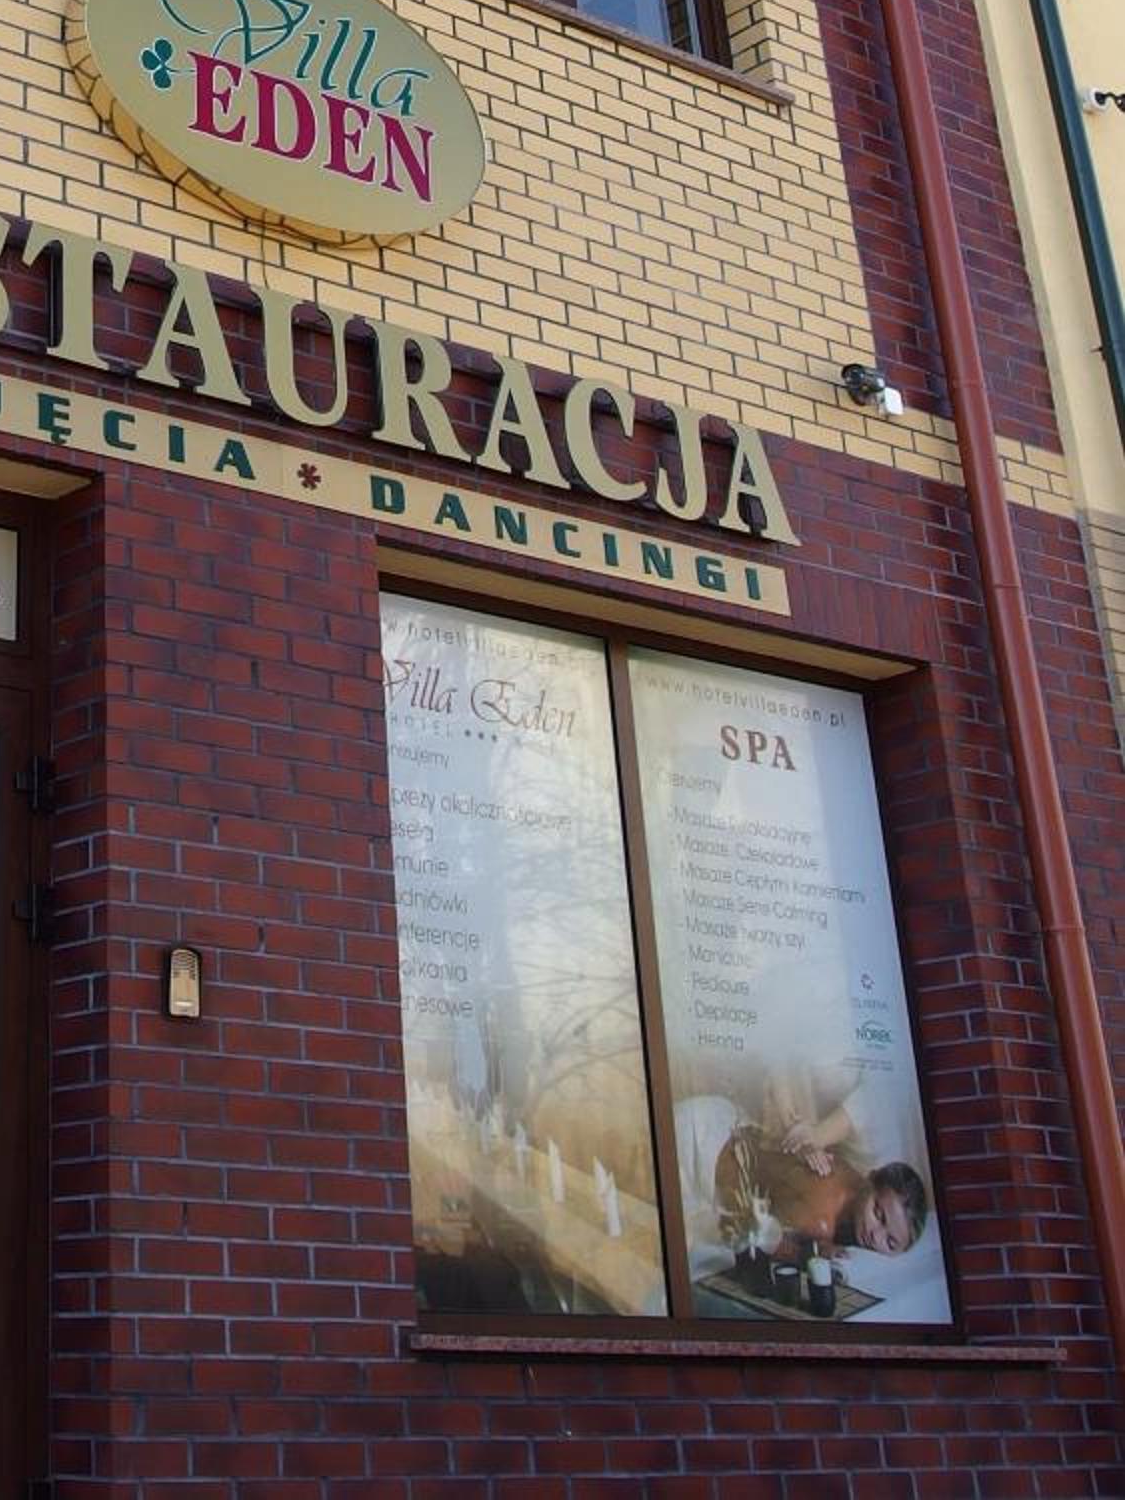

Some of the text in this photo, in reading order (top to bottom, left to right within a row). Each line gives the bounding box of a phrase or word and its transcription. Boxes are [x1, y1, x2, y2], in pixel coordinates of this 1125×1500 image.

[187, 49, 435, 204] EDEN
[370, 473, 761, 601] DANCINGI
[382, 659, 580, 737] Villa Eden
[719, 724, 796, 772] SPA
